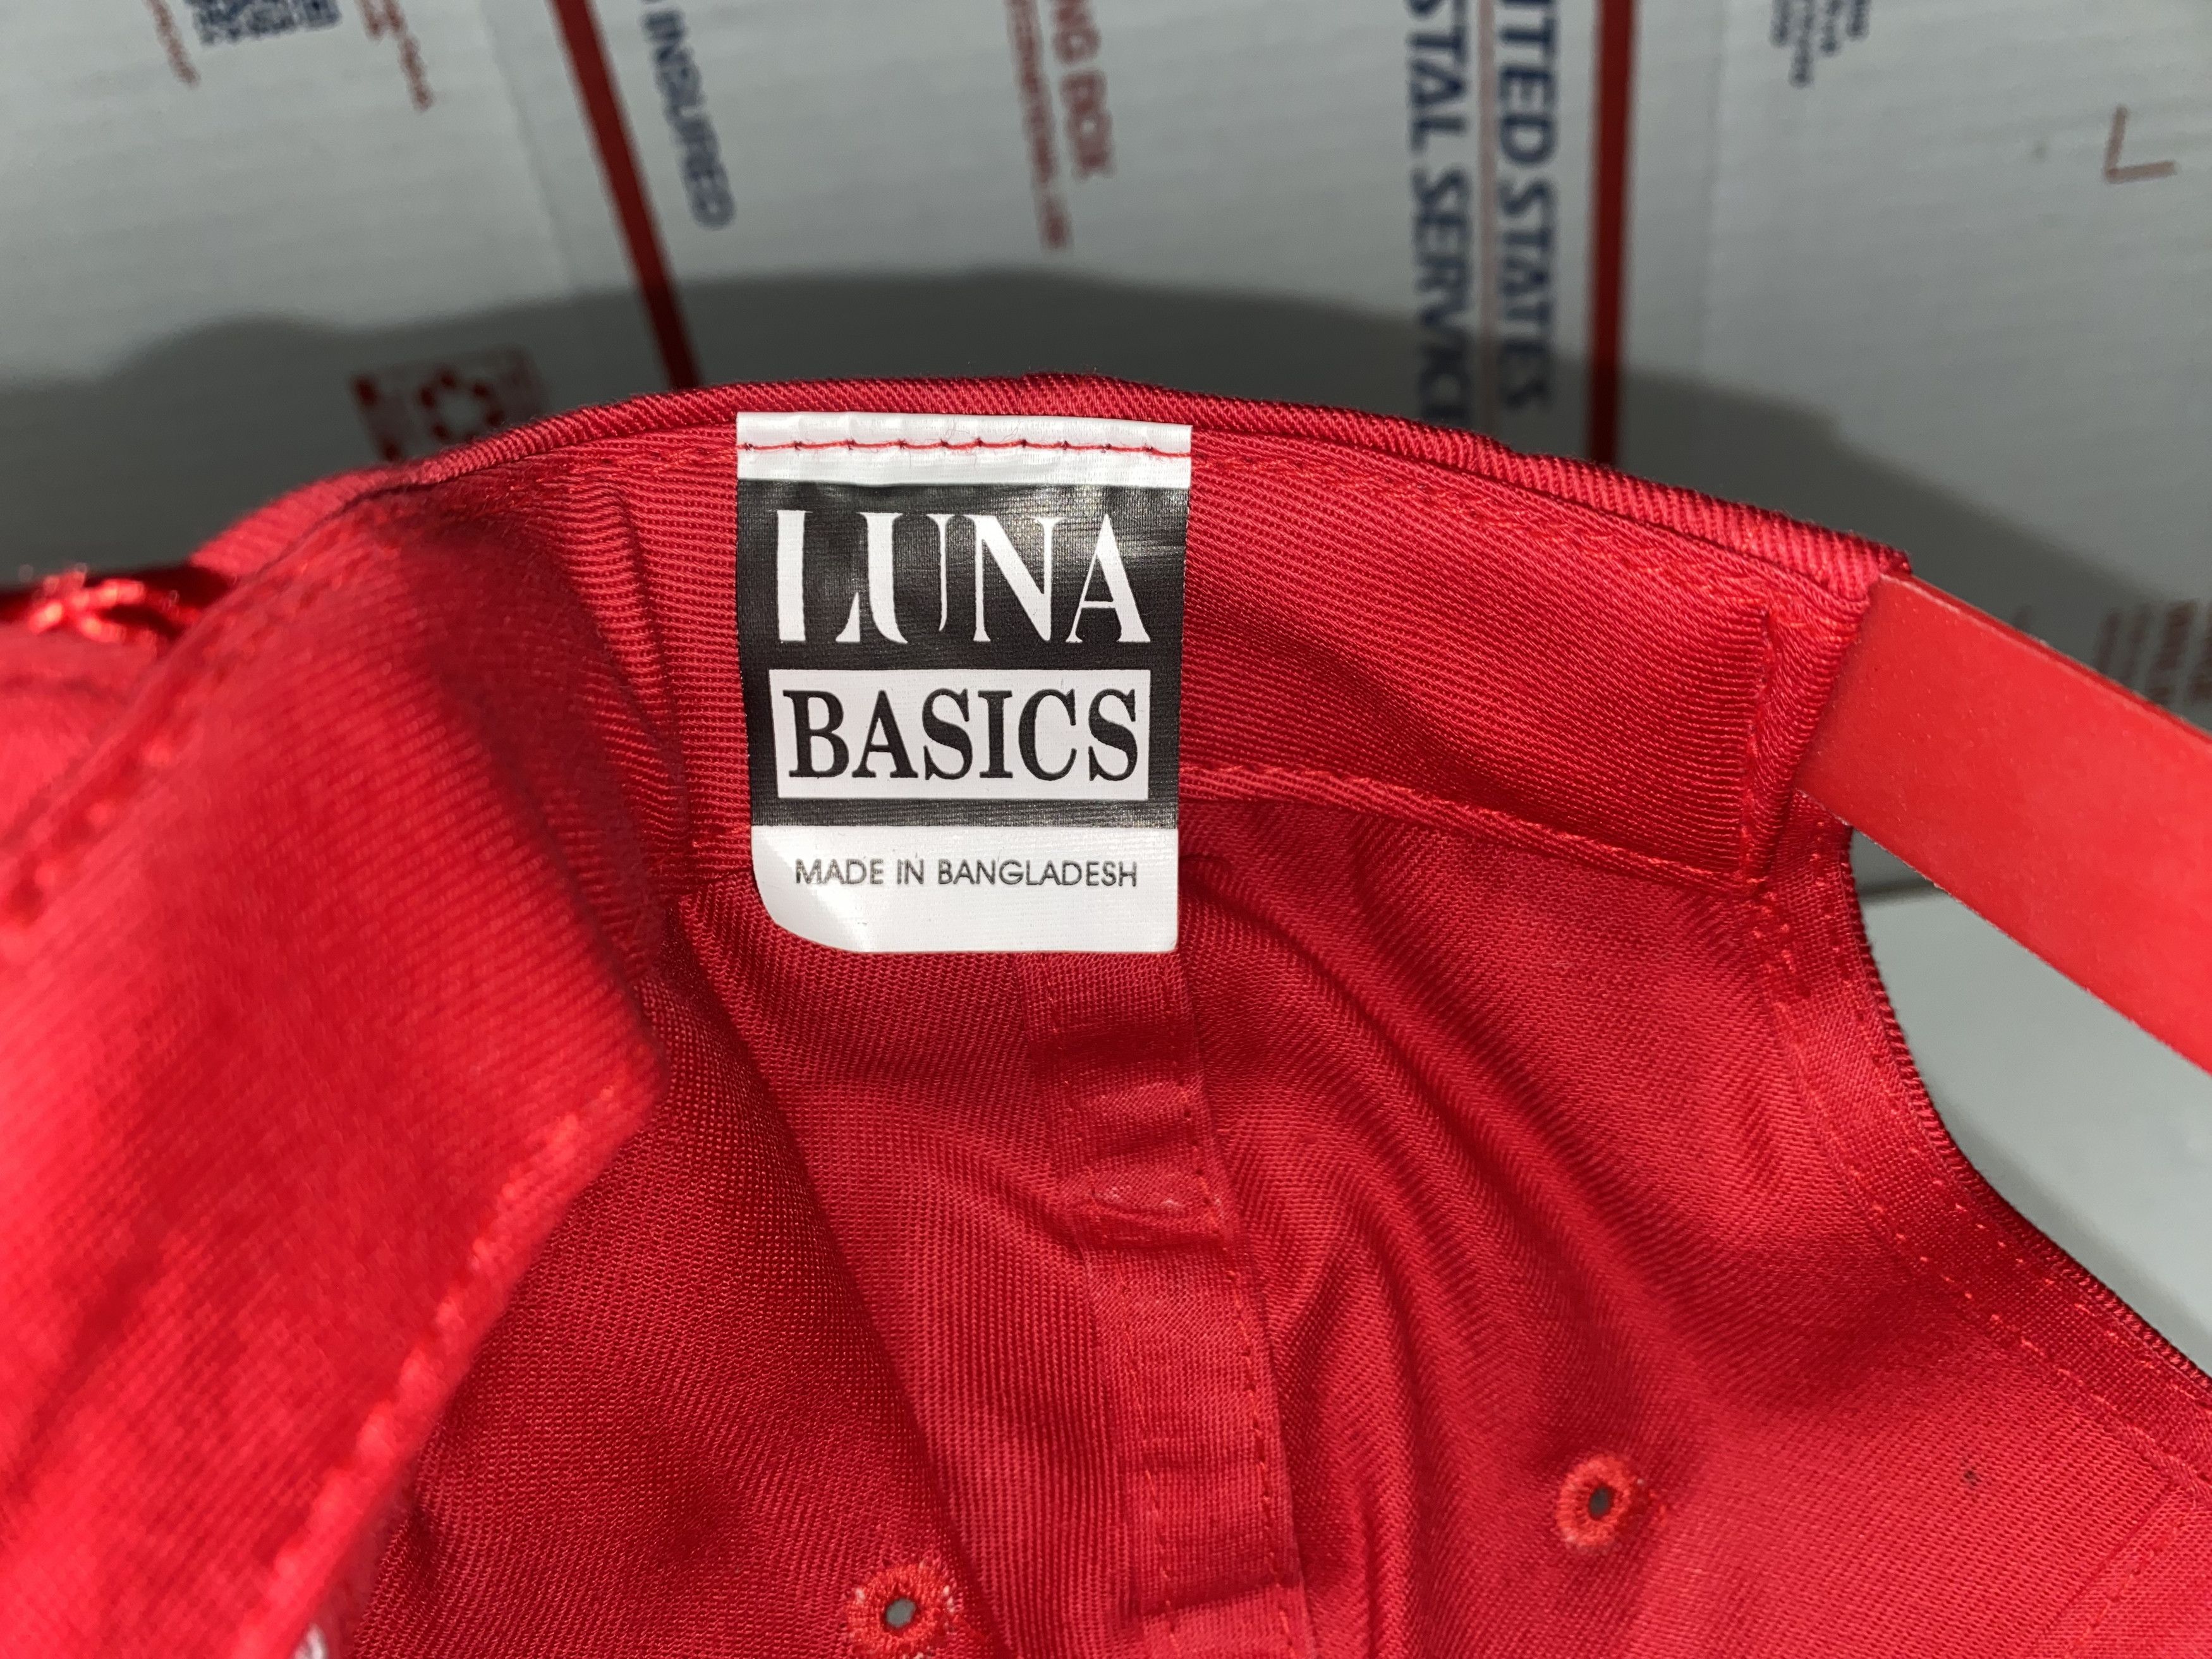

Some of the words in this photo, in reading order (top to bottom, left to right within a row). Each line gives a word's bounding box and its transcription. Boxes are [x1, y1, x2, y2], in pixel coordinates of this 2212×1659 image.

[1498, 176, 1557, 412] STATES
[775, 509, 1152, 645] LUNA
[782, 688, 1138, 782] BASICS
[794, 858, 885, 885] MADE
[896, 858, 925, 885] IN
[937, 858, 1138, 887] BANGLADESH
